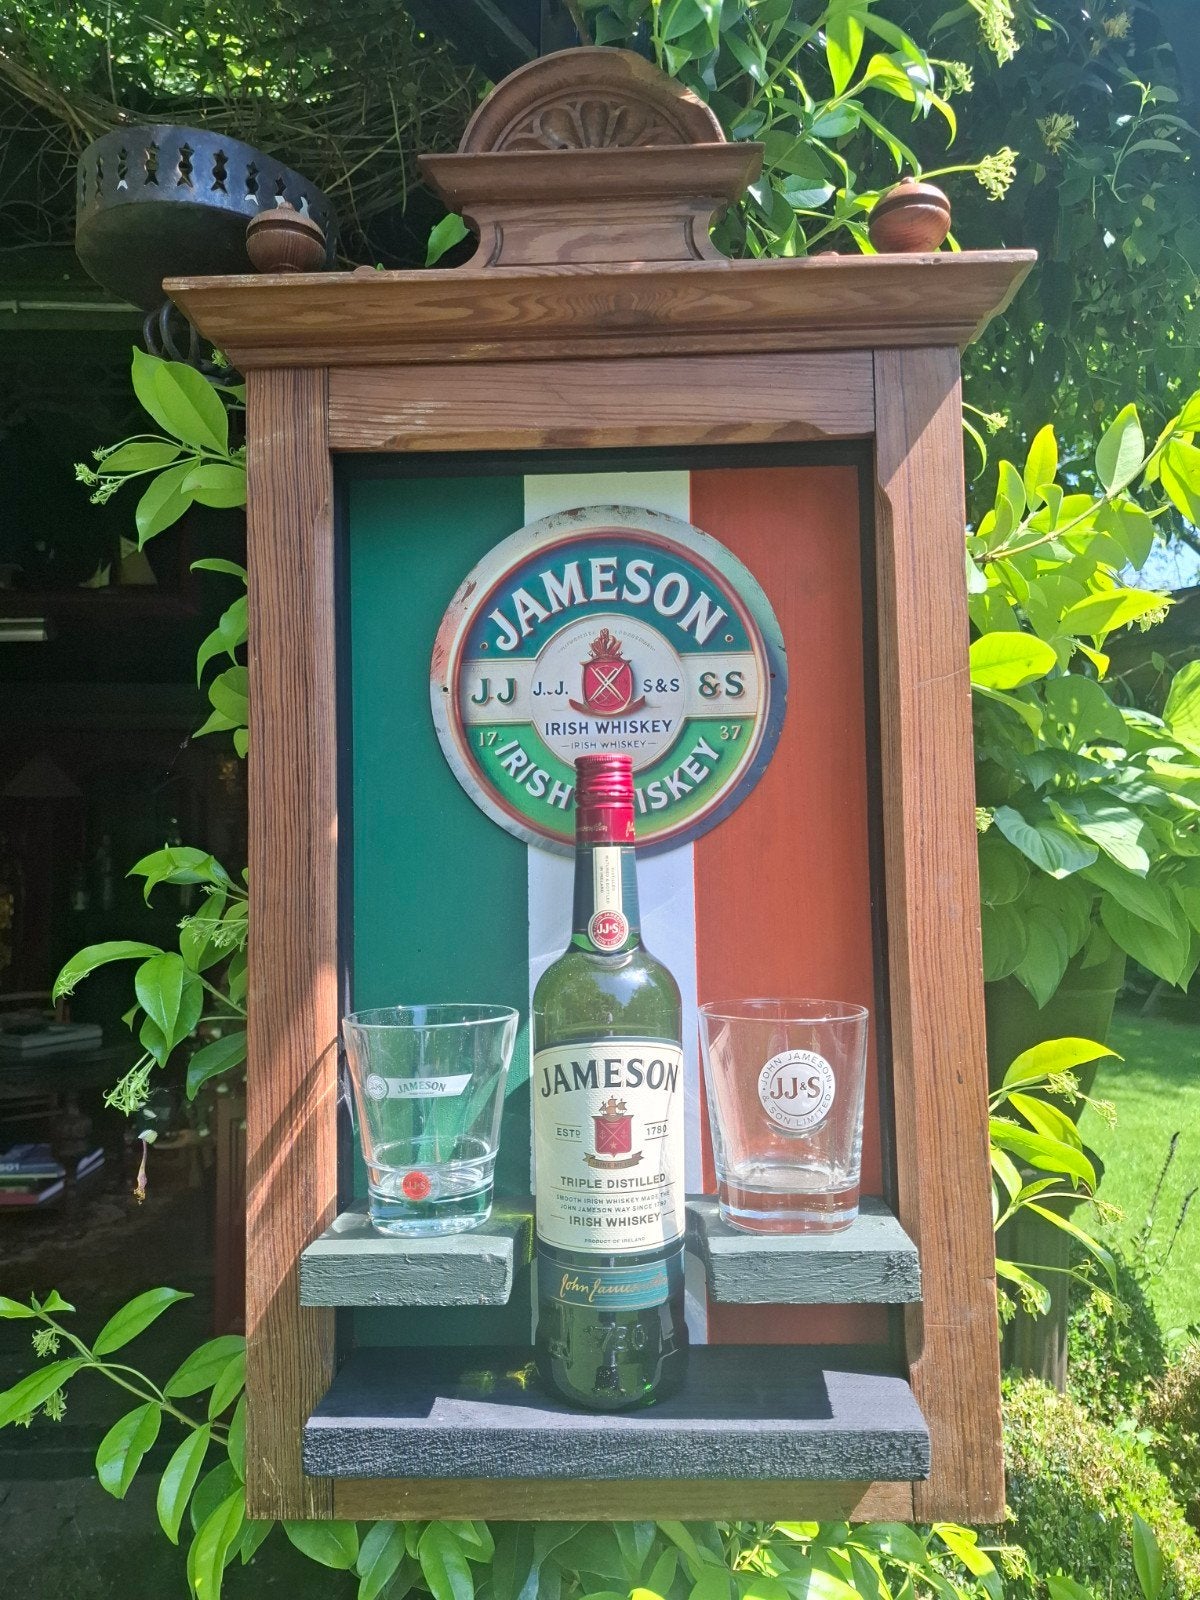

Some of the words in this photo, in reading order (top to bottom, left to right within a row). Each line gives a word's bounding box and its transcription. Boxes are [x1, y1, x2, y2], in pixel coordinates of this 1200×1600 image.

[488, 556, 728, 652] JAMESON
[643, 678, 680, 693] S&S
[698, 670, 745, 698] &S
[545, 721, 589, 736] IRISH
[595, 719, 673, 735] WHISKEY
[720, 725, 742, 740] 37
[571, 742, 597, 750] IRISH
[601, 740, 647, 750] WHISKEY
[494, 739, 575, 811] IRISH
[635, 737, 721, 814] ISKEY
[761, 1058, 782, 1086] JOHN
[788, 1052, 833, 1081] JAMESON
[541, 1058, 680, 1098] JAMESON
[397, 1081, 447, 1094] JAMESON
[770, 1076, 820, 1100] JJ&S
[769, 1107, 791, 1124] SON
[796, 1094, 831, 1126] LIMITED
[646, 1124, 667, 1136] 1780
[560, 1176, 602, 1189] TRIPLE
[607, 1173, 666, 1189] DISTILLED
[556, 1194, 582, 1203] SMOOTH
[632, 1204, 653, 1212] SINCE
[569, 1216, 602, 1227] IRISH
[606, 1212, 661, 1228] WHISKEY
[560, 1273, 589, 1298] John
